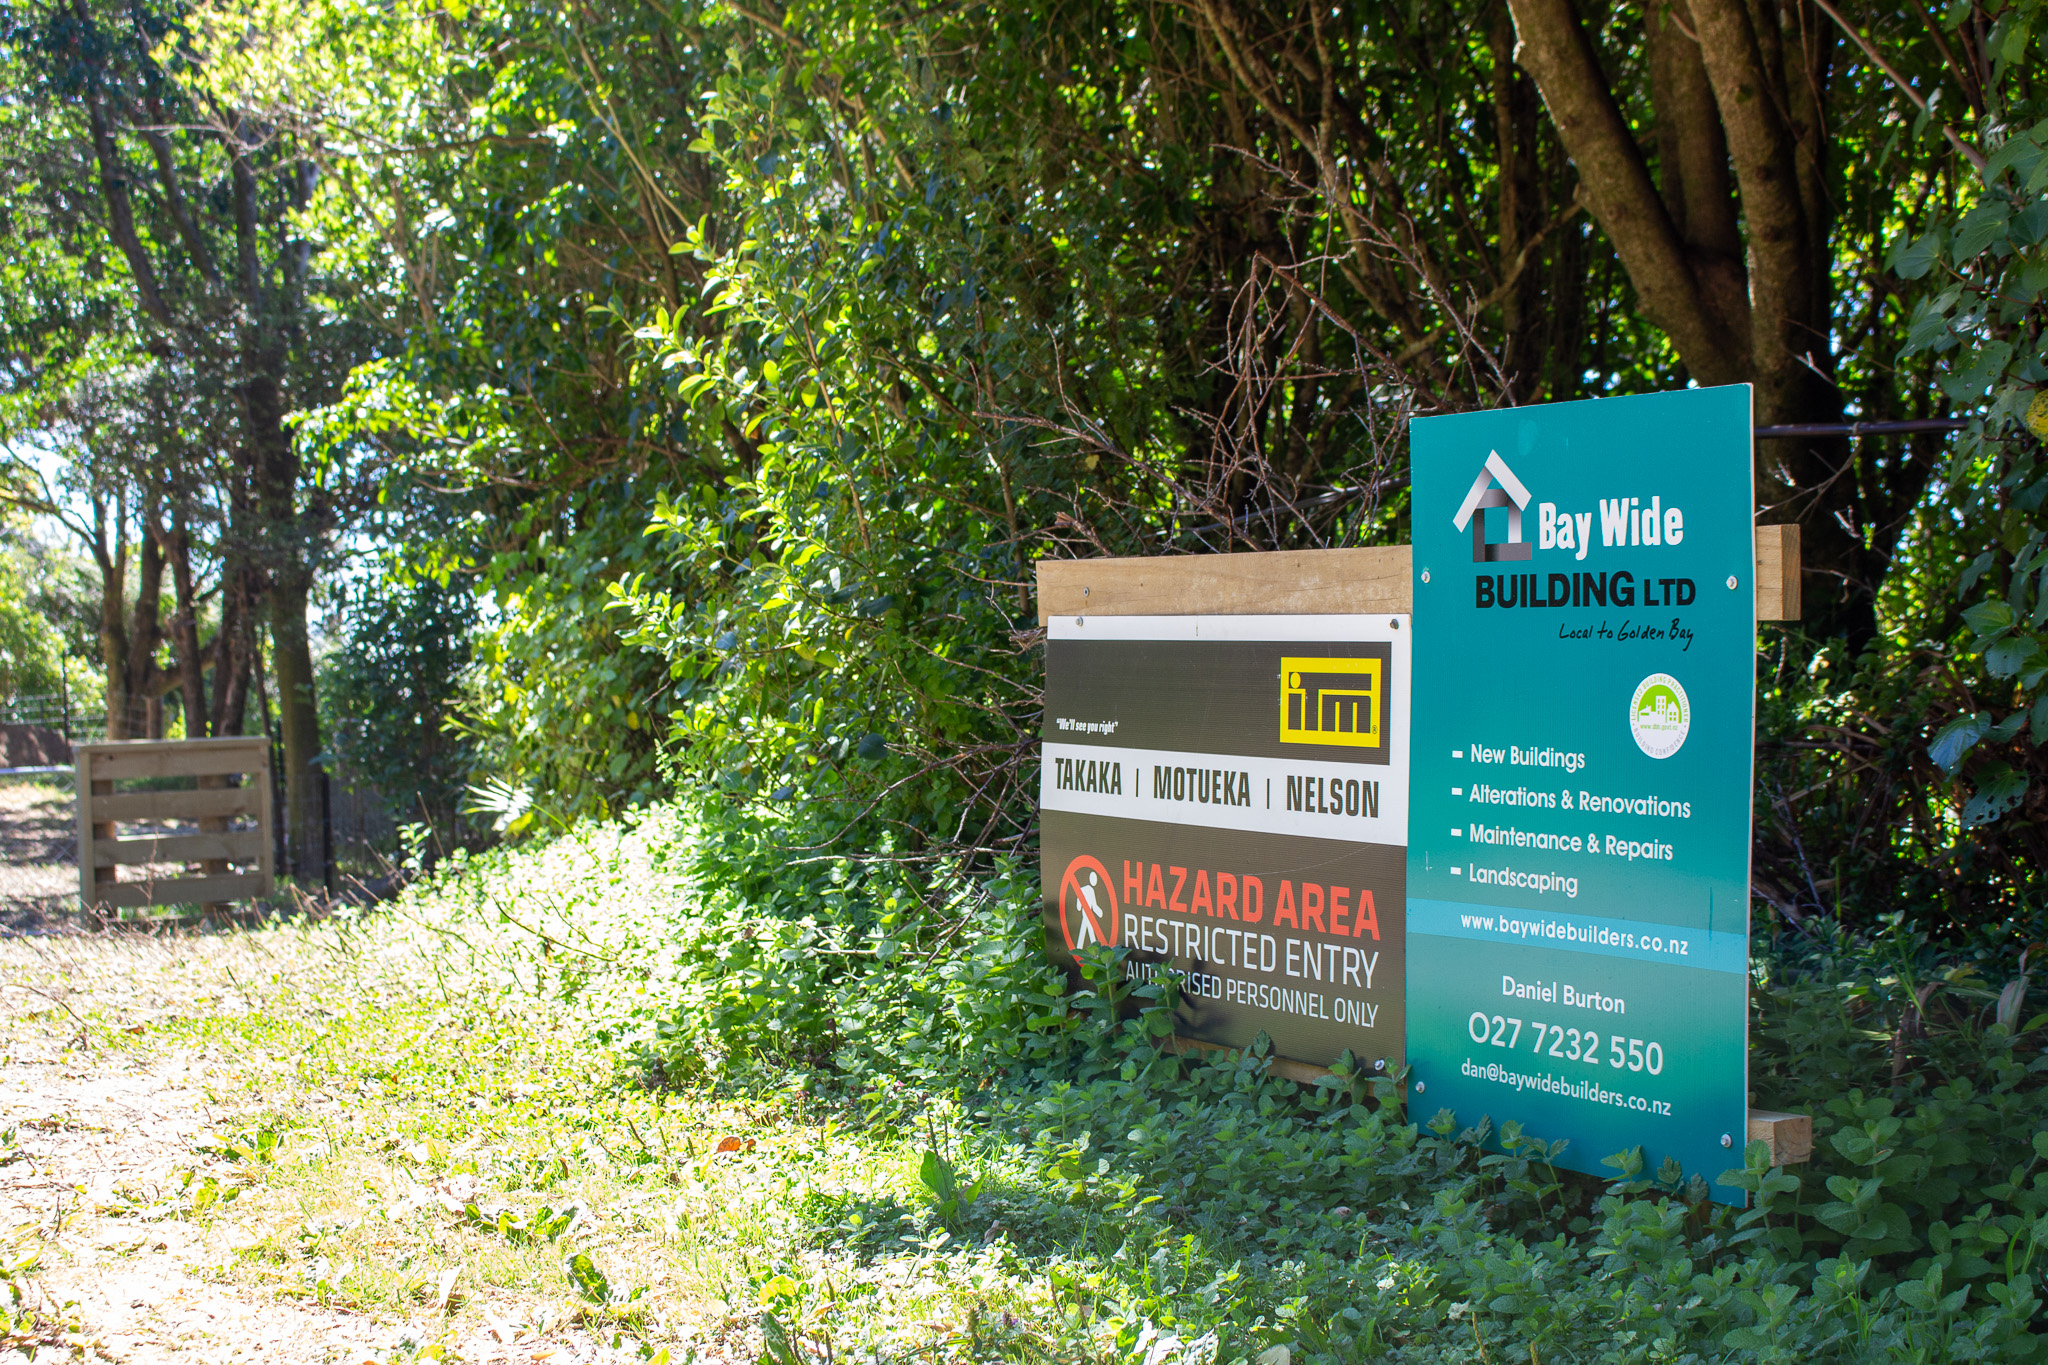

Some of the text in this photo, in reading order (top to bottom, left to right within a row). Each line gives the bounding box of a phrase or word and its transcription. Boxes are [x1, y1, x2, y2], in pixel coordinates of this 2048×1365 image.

[1539, 496, 1683, 560] Bay Wide
[1475, 571, 1696, 608] BUILDING LTD
[1559, 618, 1694, 652] Local to Golden Bay
[1075, 721, 1086, 731] see
[1087, 722, 1098, 734] you
[1470, 744, 1586, 773] New Buildings
[1055, 757, 1379, 819] TAKAKA MOTUEKA NELSON
[1469, 784, 1691, 819] Alterations & Renovations
[1469, 823, 1674, 861] Maintenance & Repairs
[1123, 860, 1381, 941] HAZARD AREA
[1469, 863, 1579, 898] Landscaping
[1124, 914, 1379, 989] RESTRICTED ENTRY
[1460, 914, 1689, 955] www.baywidebuilders.co.nz
[1226, 978, 1329, 1020] PERSONNEL
[1334, 997, 1379, 1029] ONLY
[1502, 975, 1625, 1014] Daniel Burton
[1531, 1021, 1599, 1064] 7232
[1608, 1035, 1664, 1076] 550
[1461, 1057, 1672, 1116] dan@baywidebuilders.co.nz
